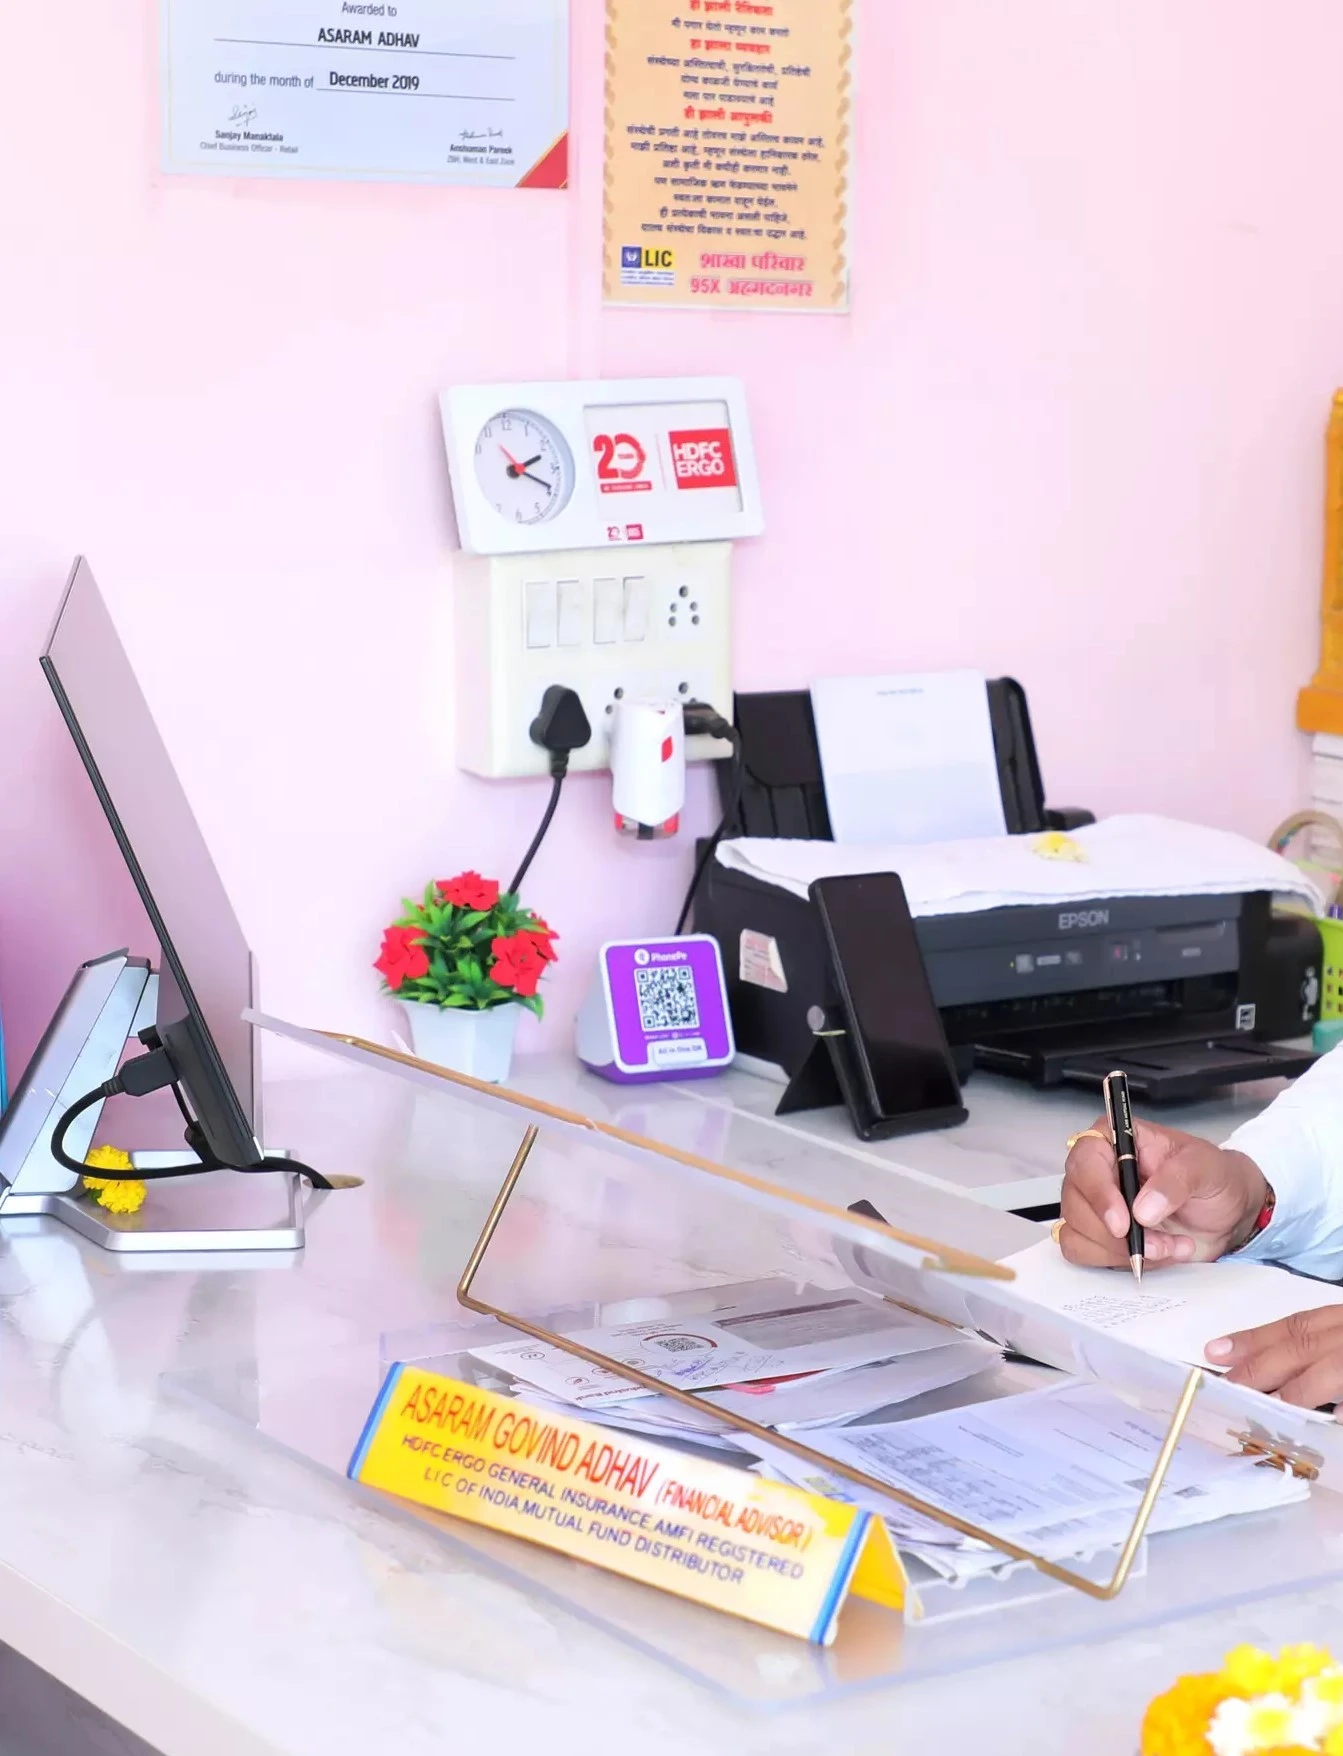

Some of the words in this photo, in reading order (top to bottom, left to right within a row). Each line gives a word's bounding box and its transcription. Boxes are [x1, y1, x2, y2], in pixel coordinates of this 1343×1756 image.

[342, 2, 385, 17] Awarded
[387, 6, 397, 17] to
[318, 28, 372, 46] ASARAM
[378, 31, 420, 48] ADHAV
[214, 71, 248, 88] during
[250, 73, 266, 86] the
[269, 73, 302, 88] month
[304, 75, 314, 88] of
[329, 72, 389, 90] December
[391, 74, 420, 91] 2019
[215, 130, 241, 142] Sanjay
[644, 250, 673, 267] LIC
[501, 419, 512, 431] 12
[592, 432, 647, 480] 20
[673, 441, 722, 460] HDFC
[677, 458, 725, 478] ERGO
[1058, 910, 1110, 930] EPSON
[651, 951, 687, 962] PhonePe
[400, 1384, 497, 1442] ASARAM
[493, 1412, 581, 1472] GOVIND
[574, 1441, 660, 1498] ADHAV
[655, 1478, 734, 1527] (FINANCIAL
[402, 1434, 441, 1457] HDFC
[442, 1448, 486, 1473] ERGO
[488, 1463, 556, 1499] GENERAL
[696, 1532, 804, 1580] REGISTERED
[456, 1478, 476, 1495] OF
[588, 1521, 632, 1548] FUND
[635, 1534, 744, 1584] DISTRIBUTOR
